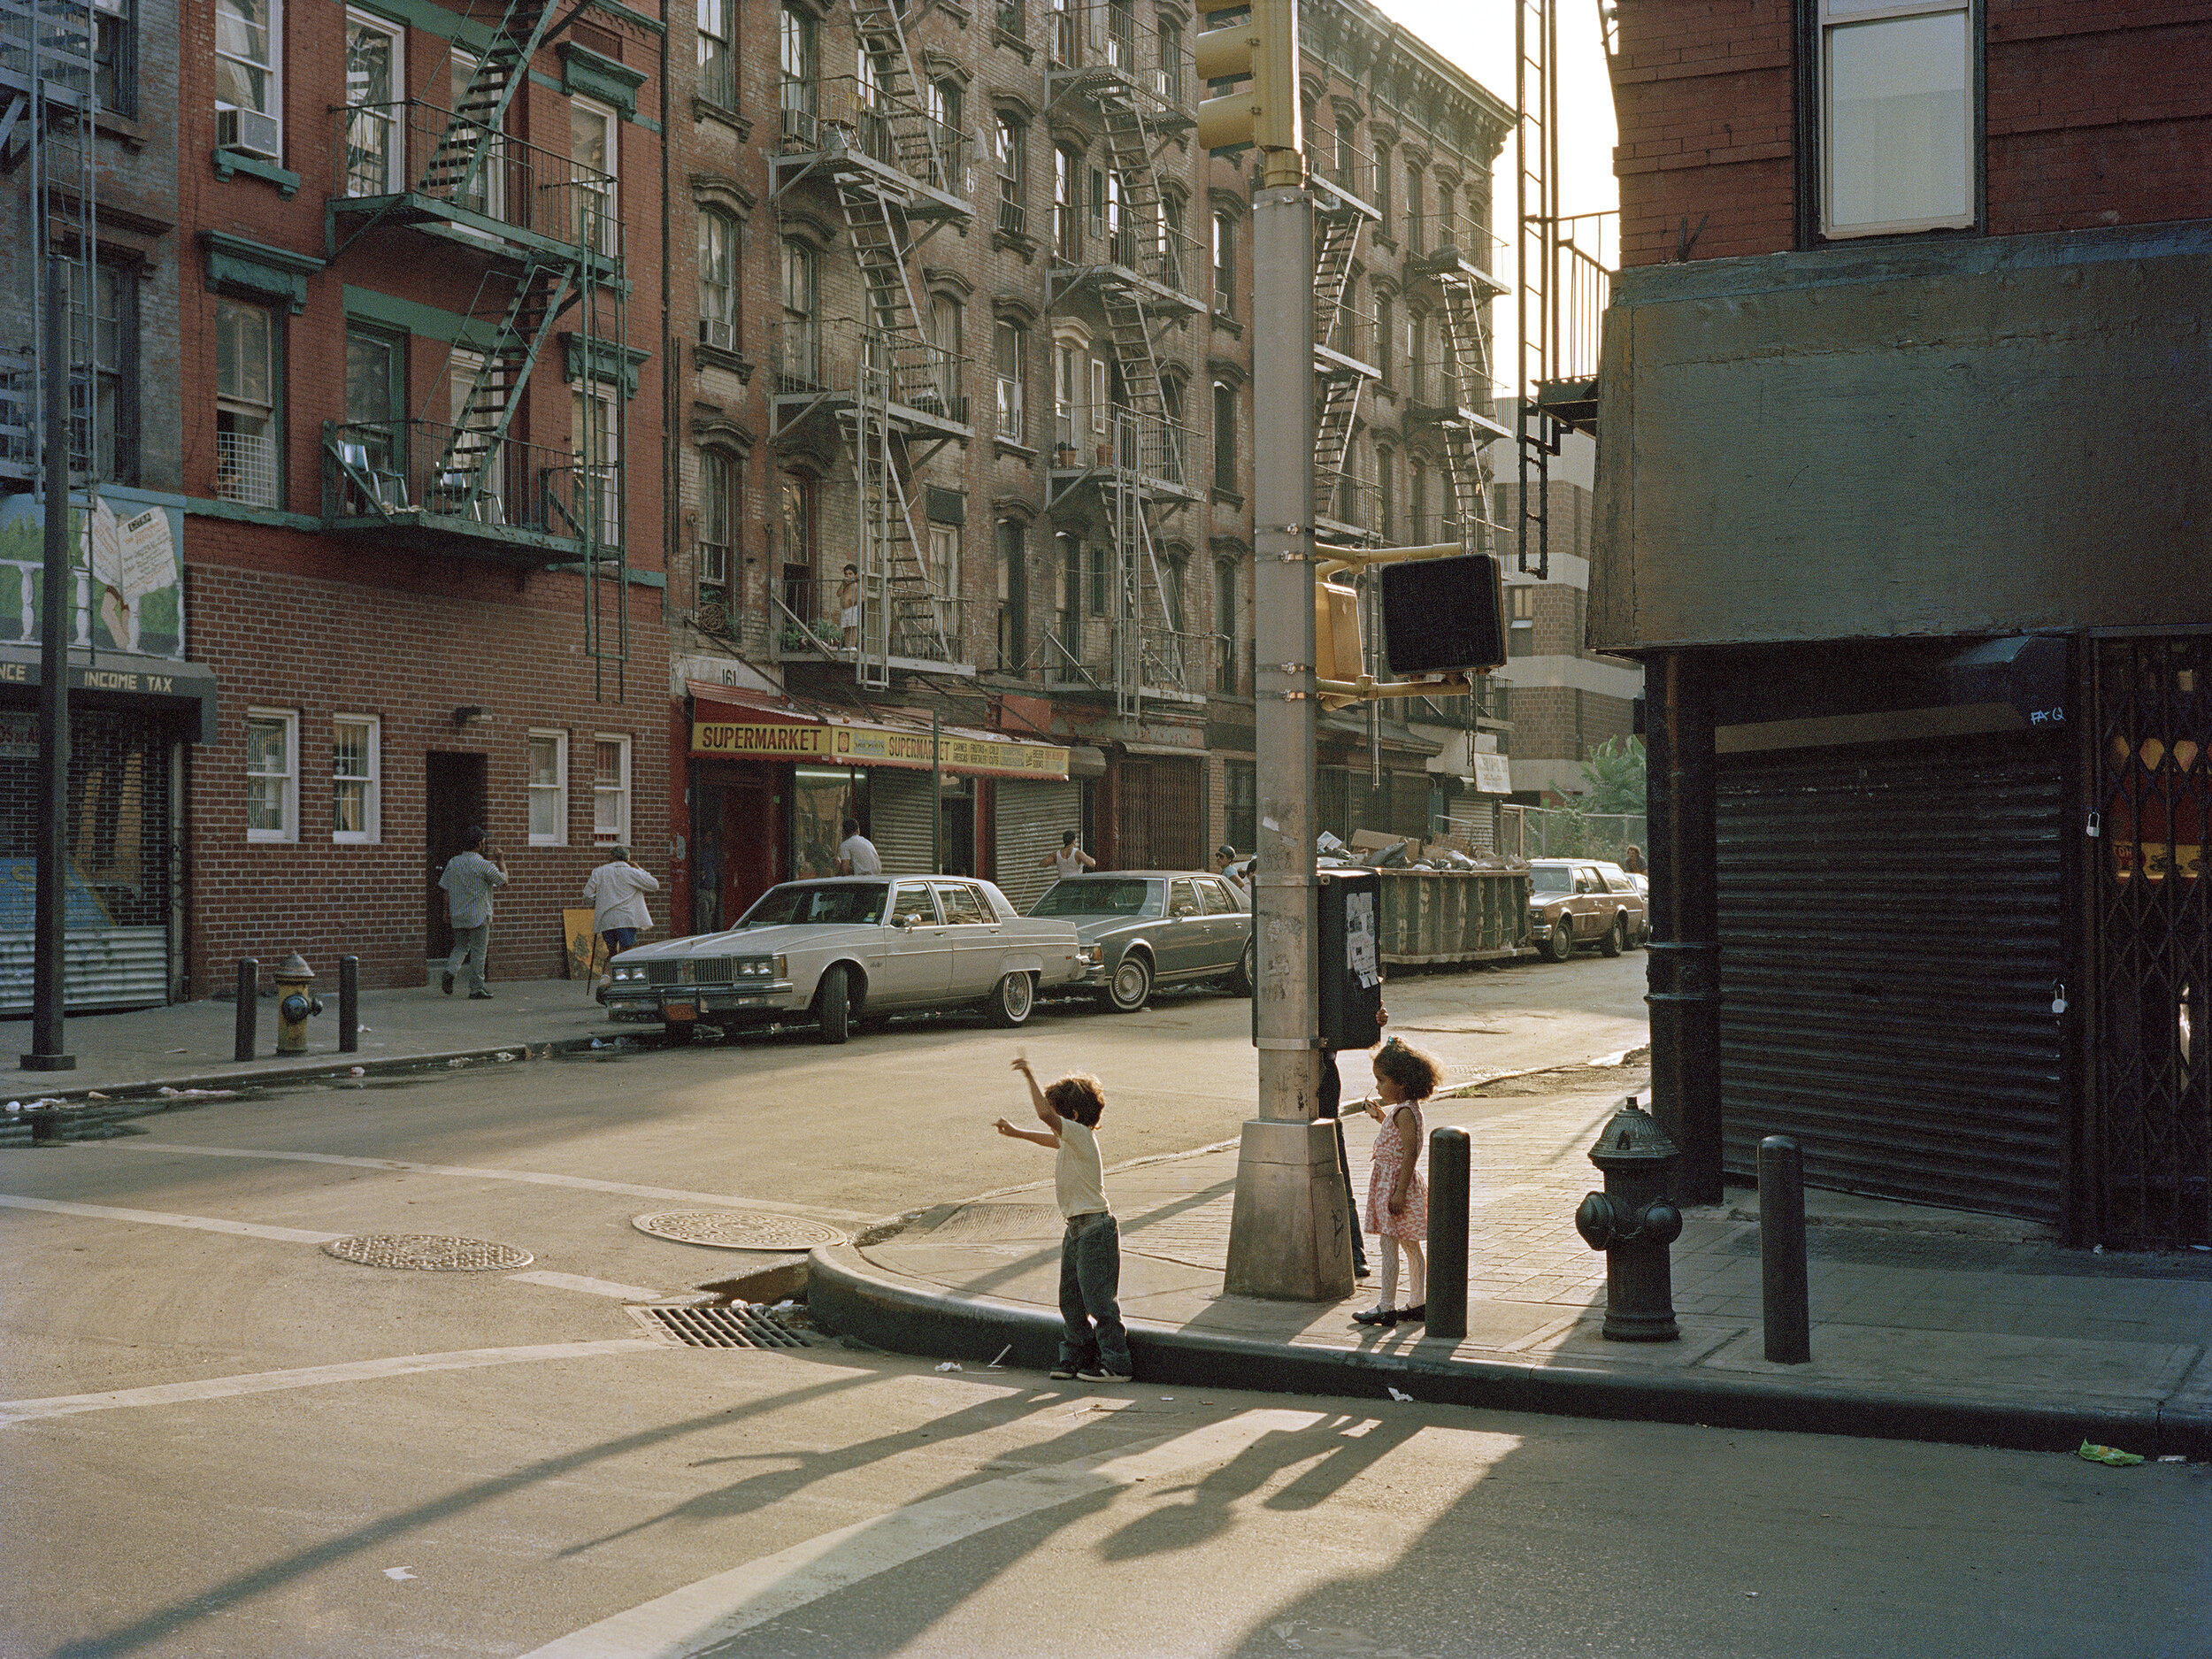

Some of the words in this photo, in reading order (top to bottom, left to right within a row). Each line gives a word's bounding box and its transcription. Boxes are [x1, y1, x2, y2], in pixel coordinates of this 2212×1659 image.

[84, 671, 138, 691] INCOME
[147, 675, 173, 693] TAX
[722, 668, 737, 687] 161
[703, 726, 822, 751] SUPERMARKET
[888, 735, 950, 761] SUPERMARET
